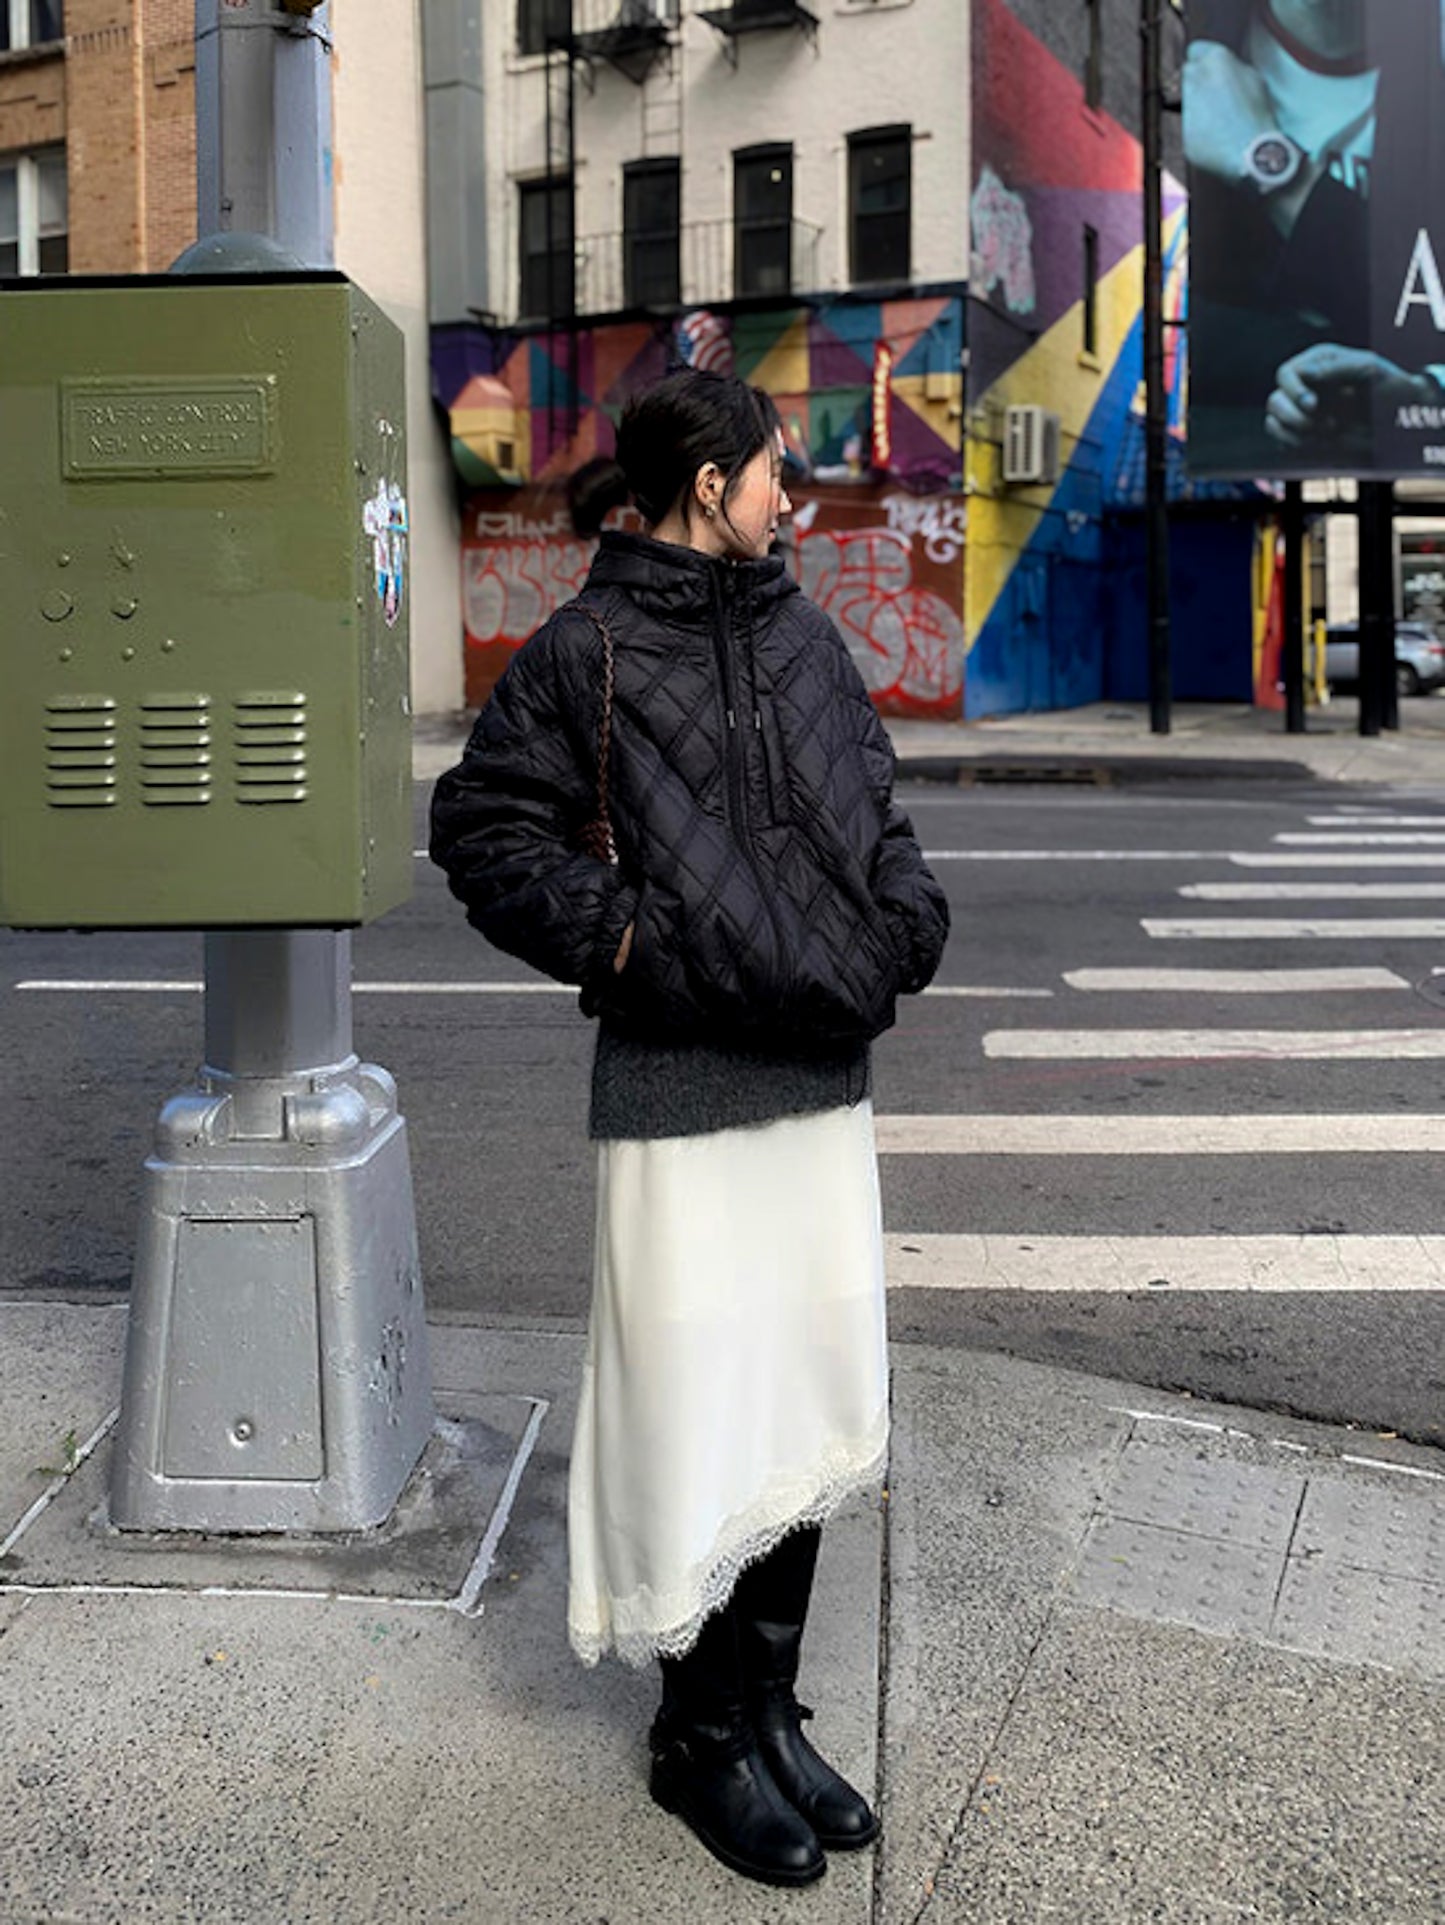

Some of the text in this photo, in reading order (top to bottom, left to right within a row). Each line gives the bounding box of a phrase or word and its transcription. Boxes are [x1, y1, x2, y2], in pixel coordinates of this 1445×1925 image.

[76, 402, 258, 425] TRAFFIC CONTROL
[89, 431, 246, 455] NEW YORK CITY
